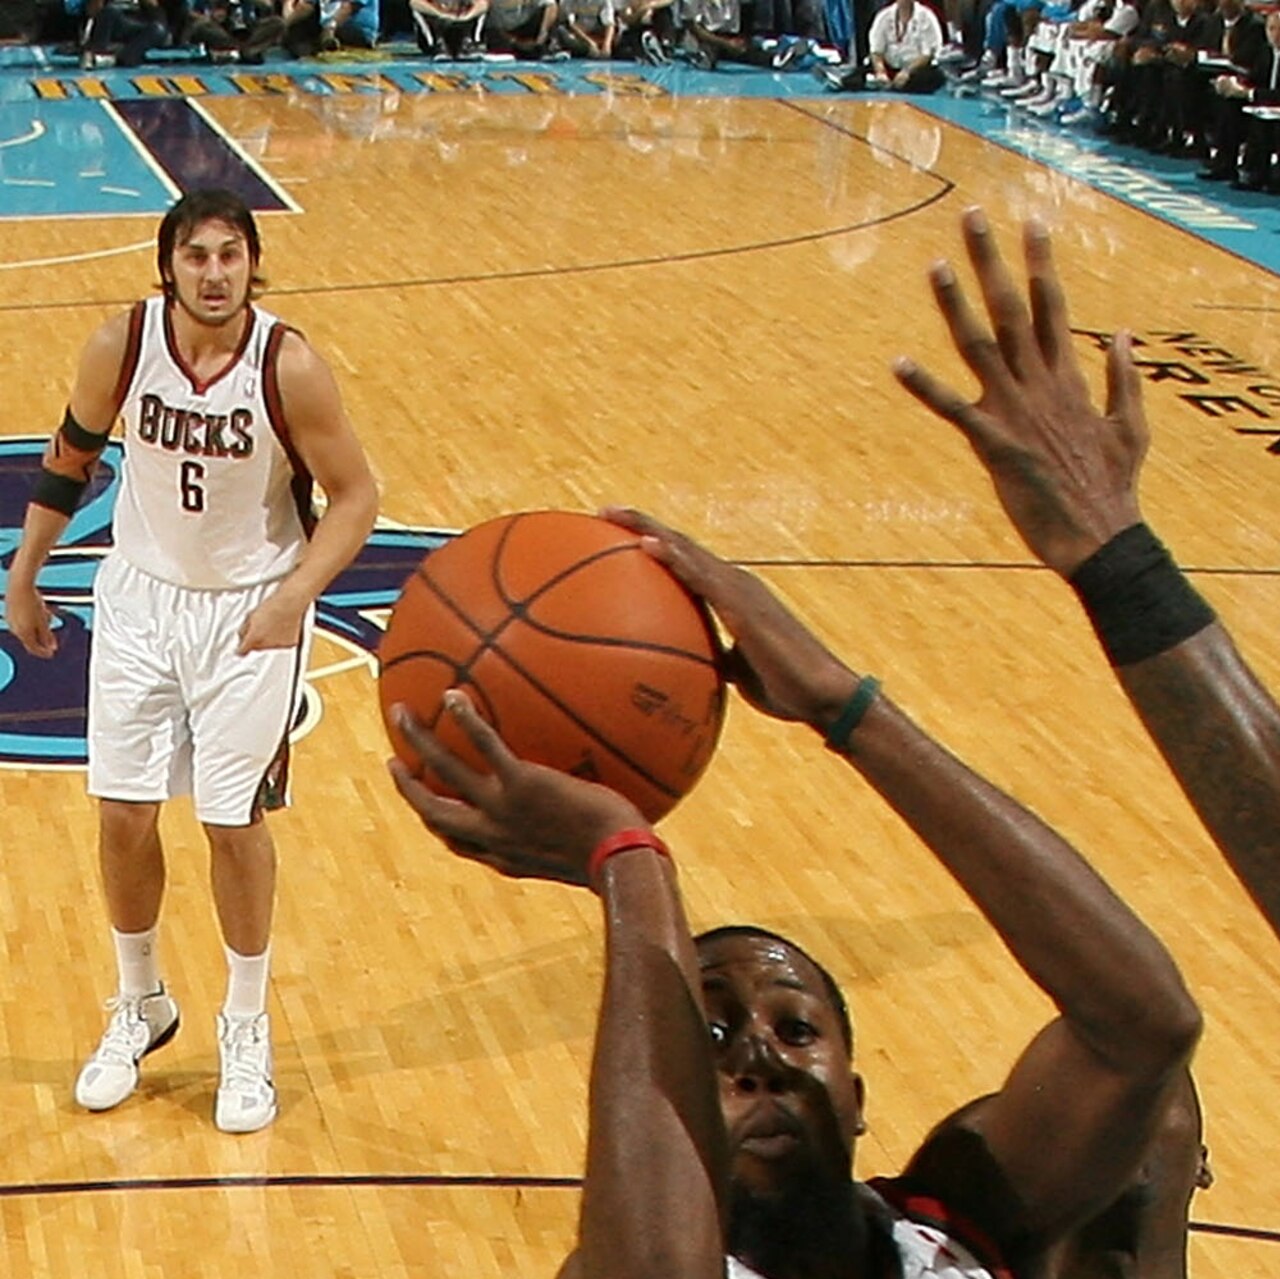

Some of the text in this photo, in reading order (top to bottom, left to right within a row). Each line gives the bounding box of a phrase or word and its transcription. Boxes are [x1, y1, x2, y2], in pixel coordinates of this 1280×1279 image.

[1146, 330, 1268, 376] NEW
[138, 393, 254, 460] BUCKS
[180, 459, 205, 513] 6
